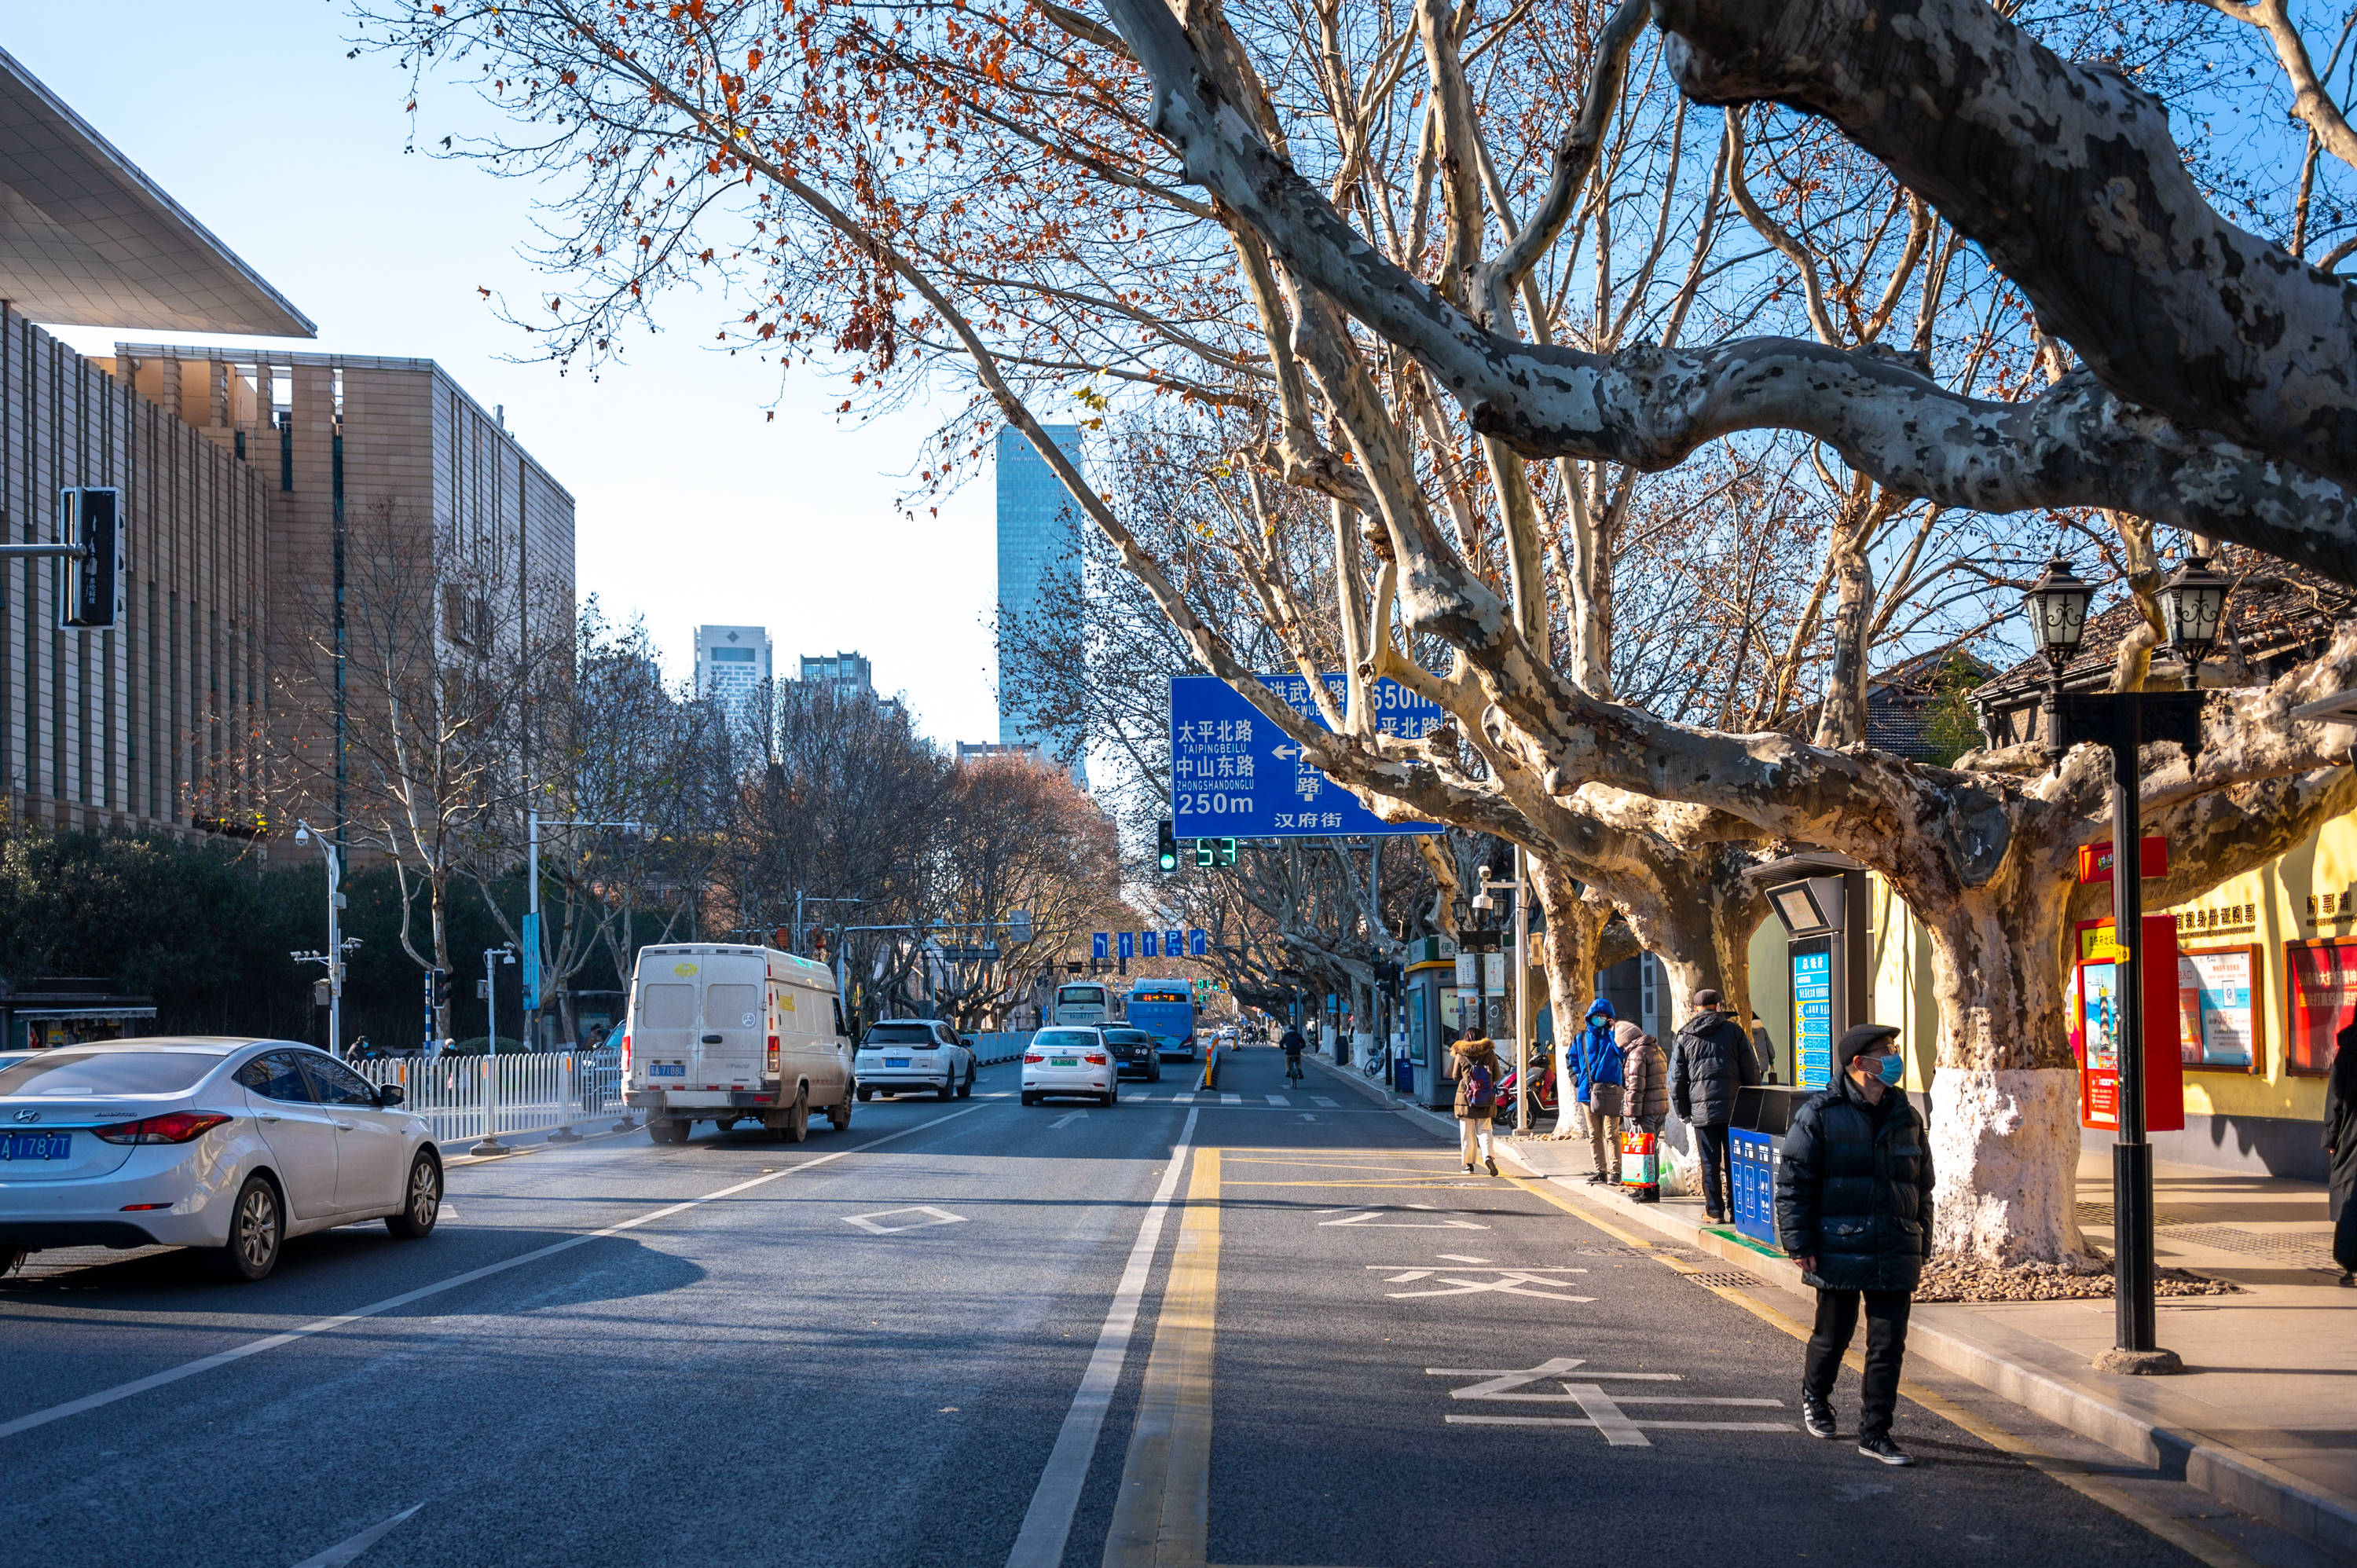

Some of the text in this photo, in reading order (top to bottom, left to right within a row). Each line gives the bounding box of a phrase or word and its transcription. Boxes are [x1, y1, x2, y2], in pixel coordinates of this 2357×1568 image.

[1270, 680, 1347, 705] 洪武路
[1373, 685, 1433, 709] 650m
[1178, 720, 1253, 744] 太平北路
[1375, 716, 1439, 738] 平北路
[1183, 744, 1247, 754] TAIPINGBEILU
[1176, 754, 1255, 778] 中山东路
[1296, 747, 1321, 793] 江路
[1177, 779, 1255, 791] ZHONGSHANDONGLU
[1178, 793, 1254, 815] 250m
[1274, 812, 1342, 829] 汉府街
[1169, 932, 1178, 943] P
